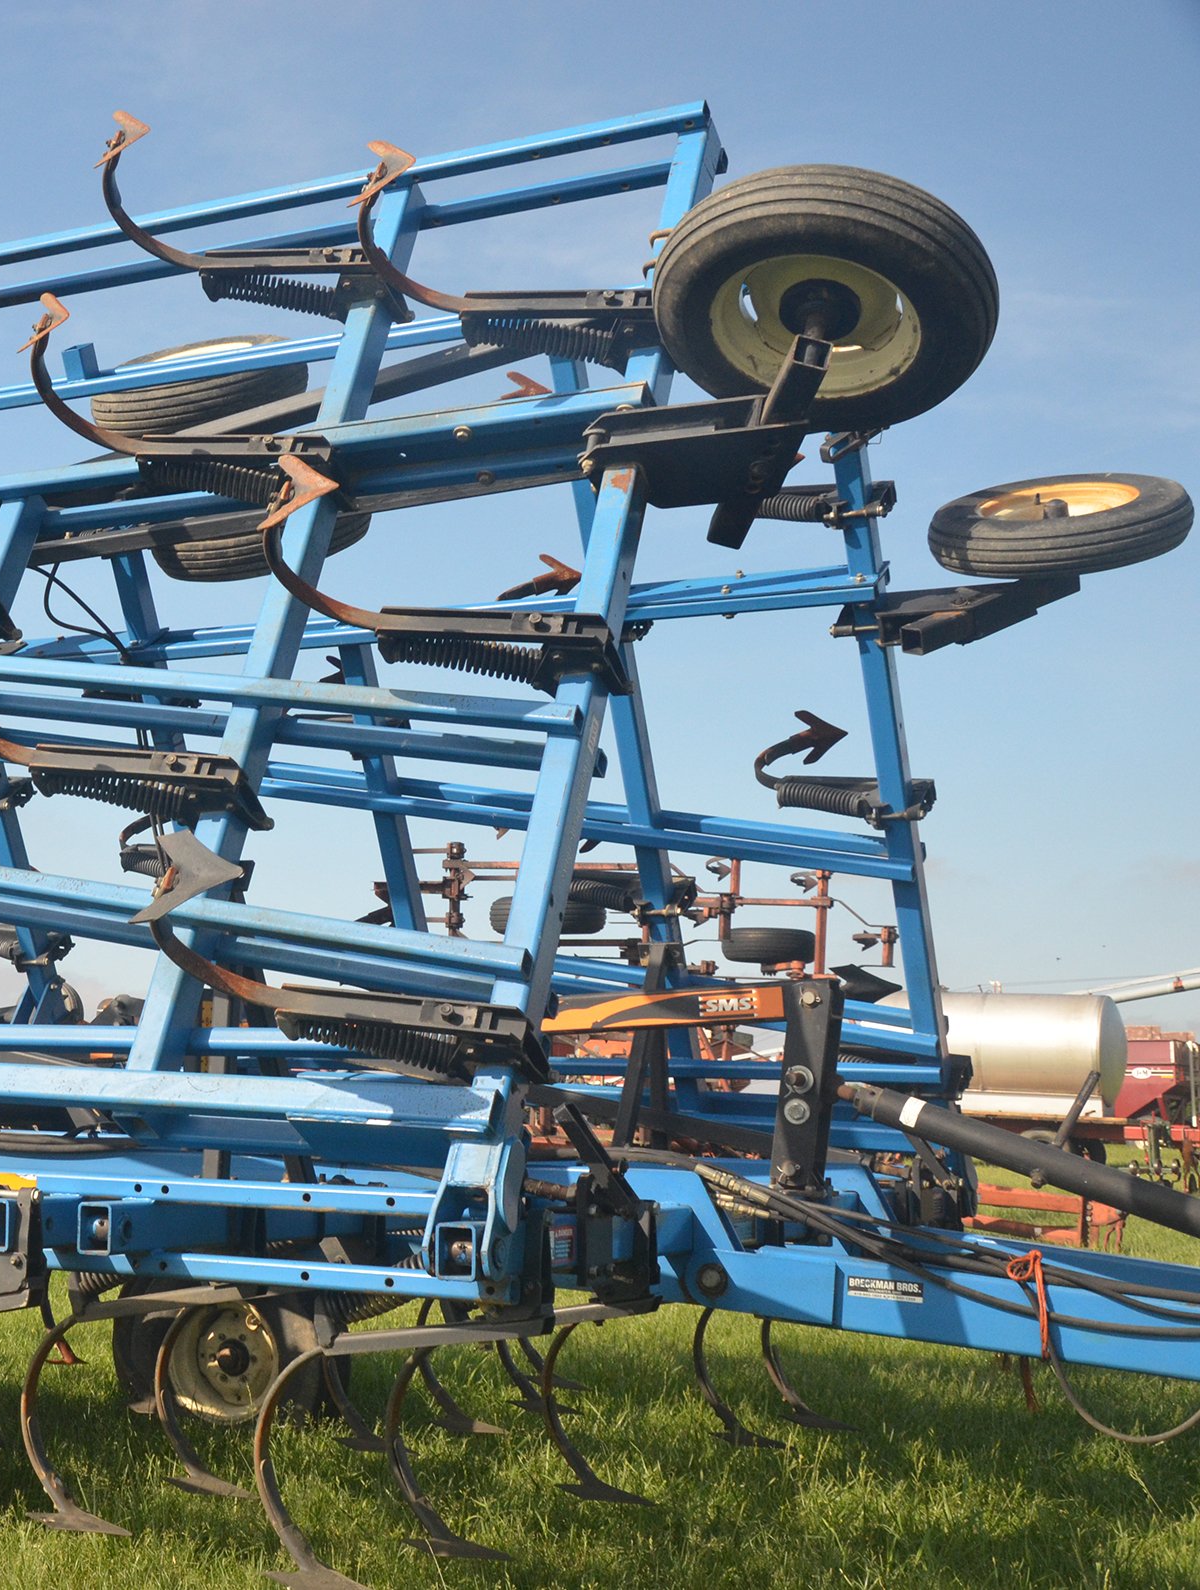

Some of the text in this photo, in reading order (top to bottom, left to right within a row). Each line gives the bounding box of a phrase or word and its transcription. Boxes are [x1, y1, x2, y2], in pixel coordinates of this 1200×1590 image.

[706, 998, 751, 1012] SMS
[849, 1278, 922, 1293] BOECKMAN BROS.
